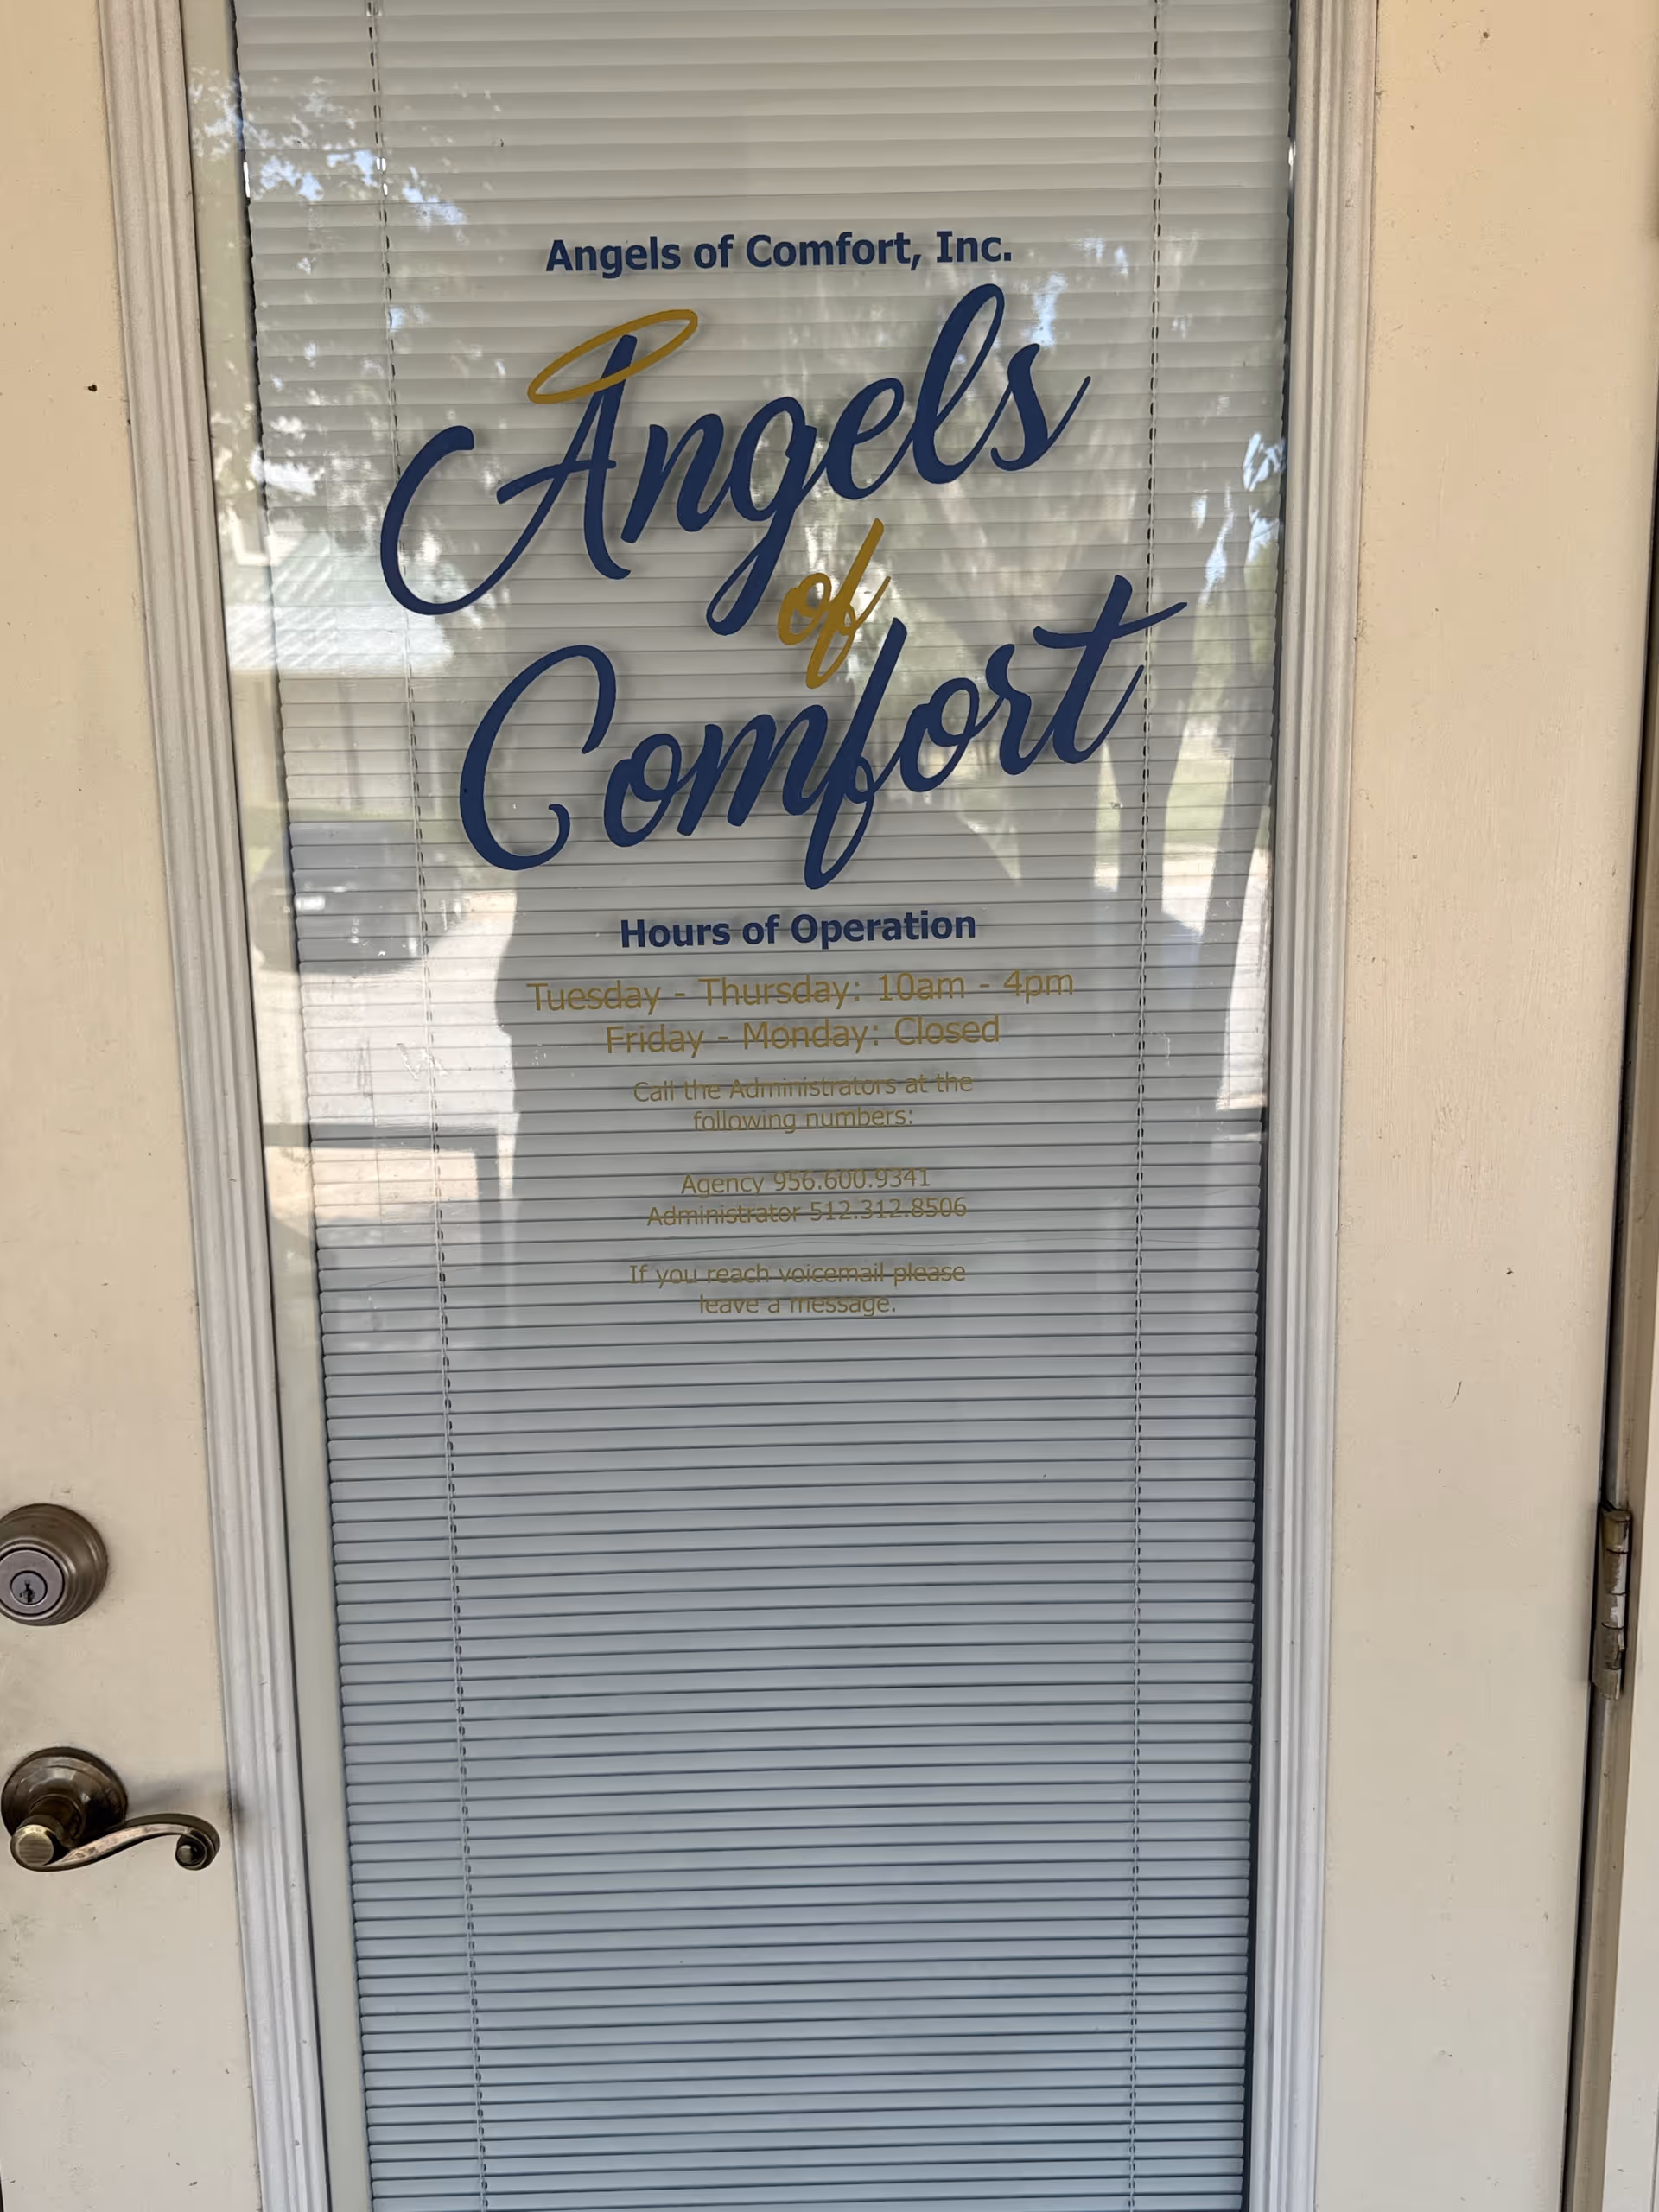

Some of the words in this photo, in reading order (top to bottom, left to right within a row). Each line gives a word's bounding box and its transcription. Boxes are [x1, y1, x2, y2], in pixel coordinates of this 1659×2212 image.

[546, 237, 681, 278] Angels
[693, 233, 734, 269] of
[746, 232, 921, 269] Comfort,
[936, 231, 1013, 264] Inc.
[380, 283, 1091, 636] Angels
[778, 518, 892, 689] of
[460, 575, 1188, 890] Comfort
[620, 919, 731, 948] Hours
[742, 914, 780, 944] of
[791, 910, 976, 950] Operation
[526, 980, 661, 1015] Tuesday
[698, 974, 860, 1010] Thursday:
[879, 972, 965, 1001] 10am
[1003, 969, 1074, 1004] 4pm
[607, 1023, 704, 1058] Friday
[743, 1018, 878, 1054] Monday:
[894, 1014, 1000, 1046] Closed
[633, 1080, 675, 1102] Call
[683, 1079, 721, 1100] the
[729, 1076, 896, 1099] Administrators
[905, 1075, 928, 1094] at
[936, 1072, 974, 1092] the
[693, 1109, 797, 1134] following
[806, 1107, 913, 1128] numbers:
[681, 1174, 764, 1198] Agency
[773, 1167, 931, 1192] 956.600.9341
[647, 1204, 801, 1226] Administrator
[810, 1197, 968, 1221] 512.312.8506
[629, 1264, 648, 1284] If
[656, 1268, 697, 1289] you
[707, 1263, 769, 1284] reach
[779, 1262, 884, 1283] voicemail
[893, 1262, 966, 1287] please
[699, 1294, 759, 1314] leave
[767, 1298, 779, 1313] a
[790, 1295, 896, 1318] message.
